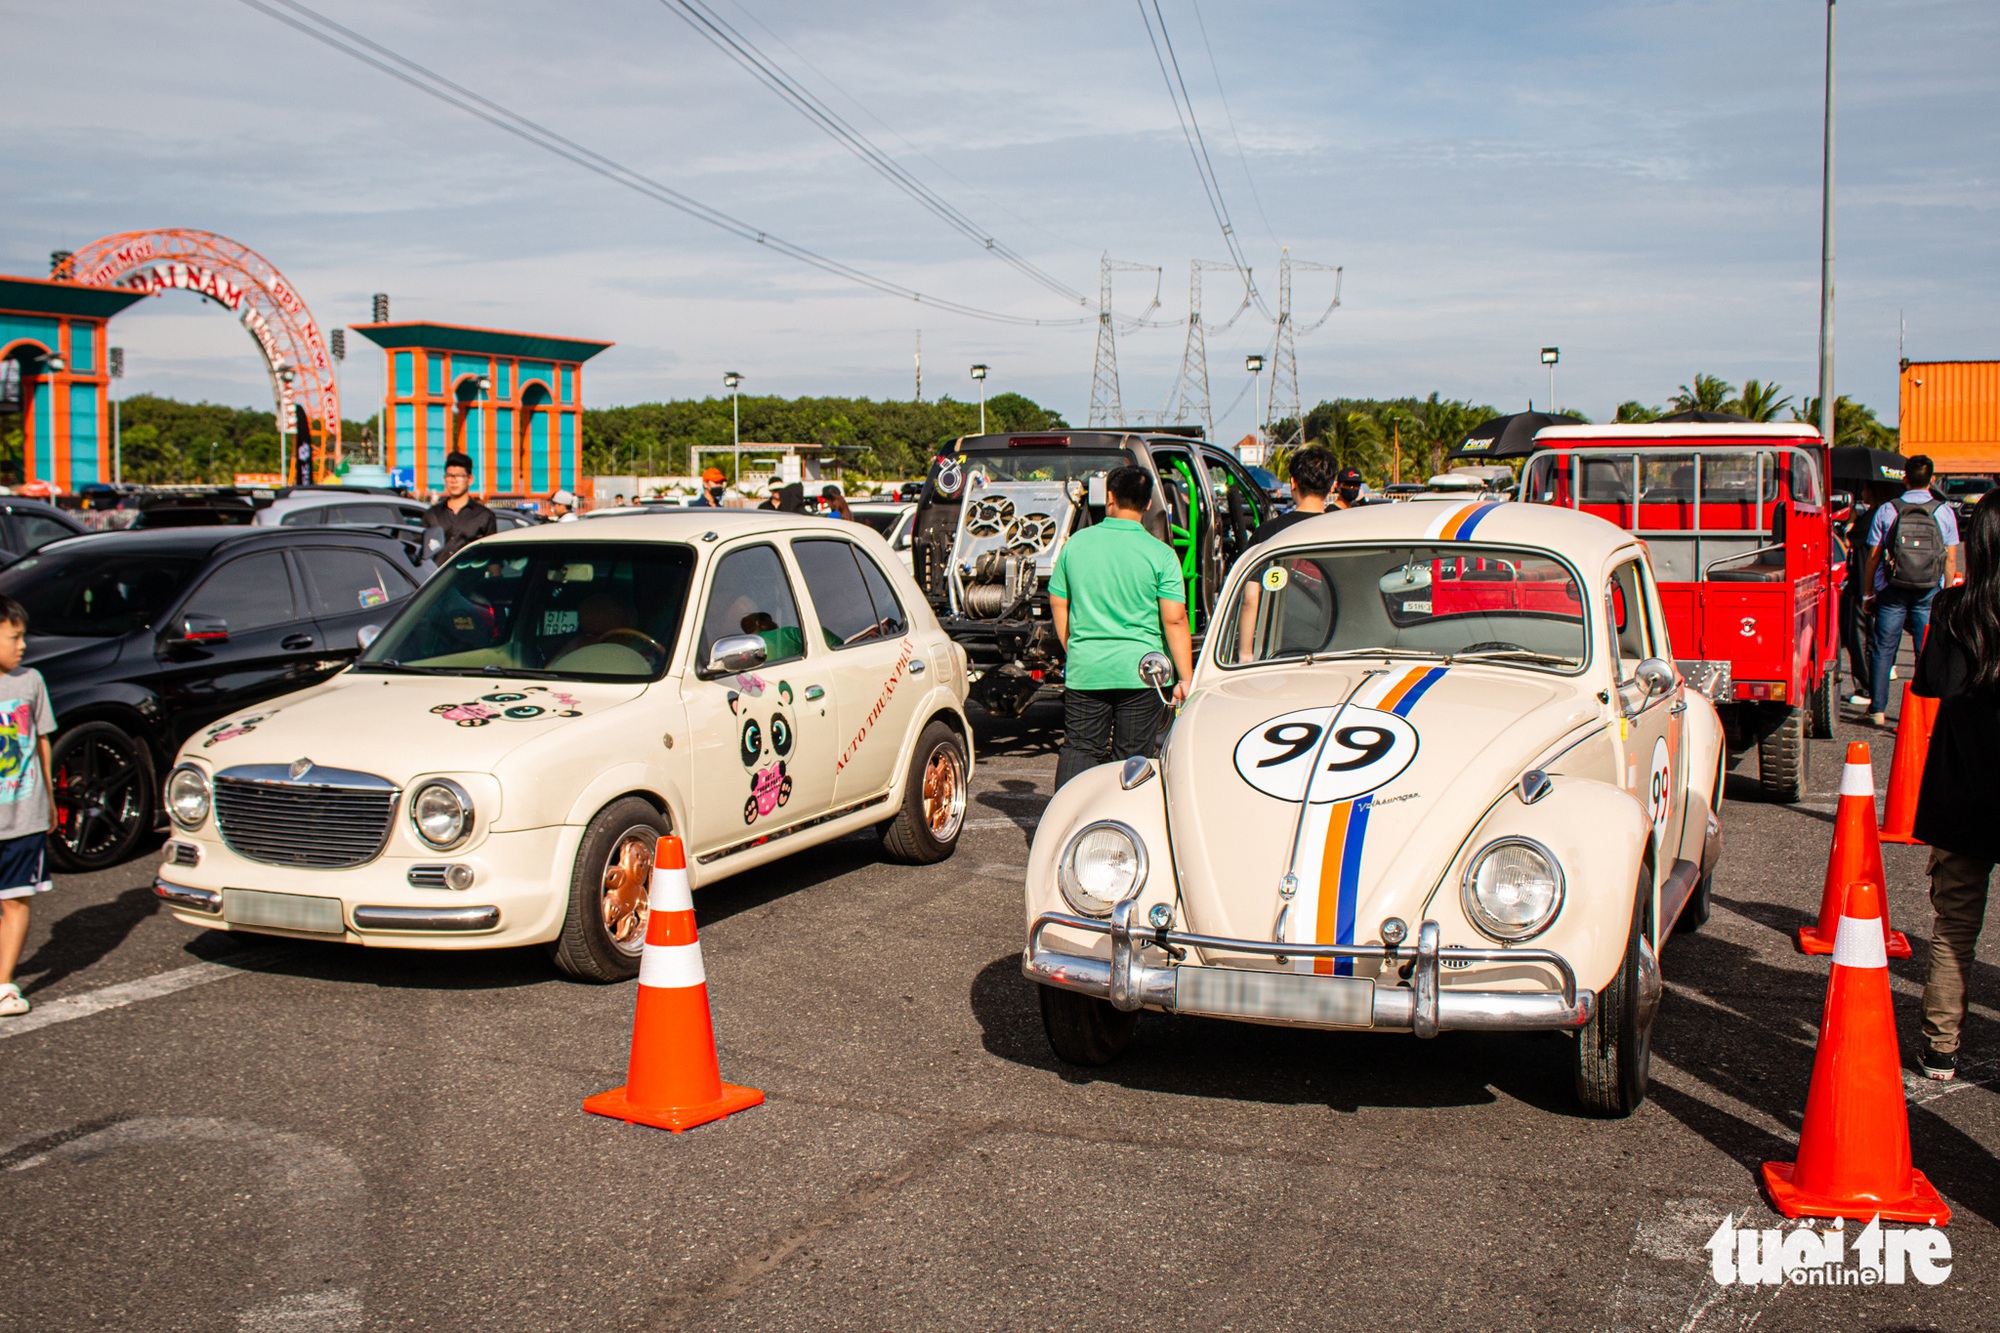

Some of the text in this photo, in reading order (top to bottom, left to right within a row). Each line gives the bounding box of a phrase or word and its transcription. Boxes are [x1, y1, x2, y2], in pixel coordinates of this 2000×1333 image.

[1271, 571, 1280, 583] 5
[836, 727, 866, 775] AUTO
[1256, 722, 1397, 772] 99
[1652, 765, 1669, 826] 99
